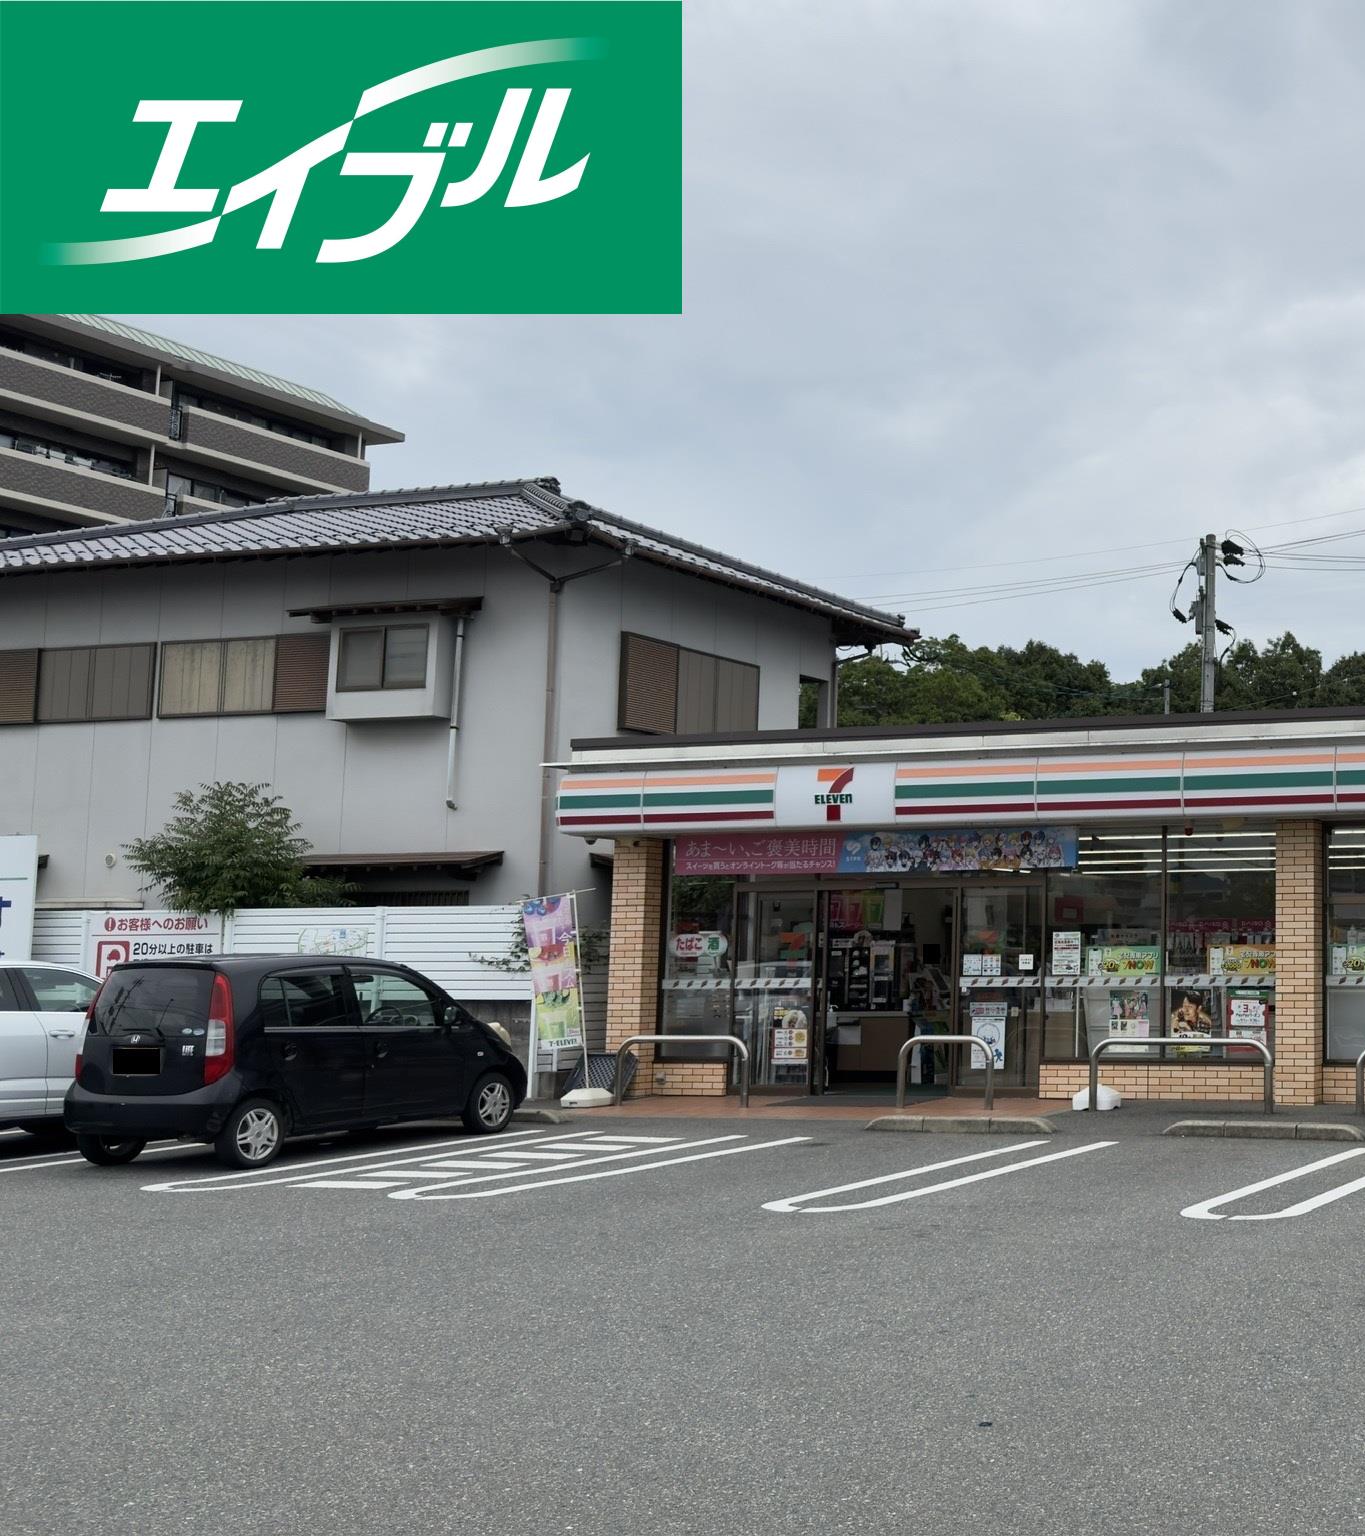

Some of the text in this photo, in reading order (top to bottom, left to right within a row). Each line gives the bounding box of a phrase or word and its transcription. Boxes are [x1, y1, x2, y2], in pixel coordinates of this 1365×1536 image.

[117, 917, 208, 932] お客様へのお願い
[133, 942, 213, 956] 20分以上の駐車は
[676, 936, 703, 951] たばこ
